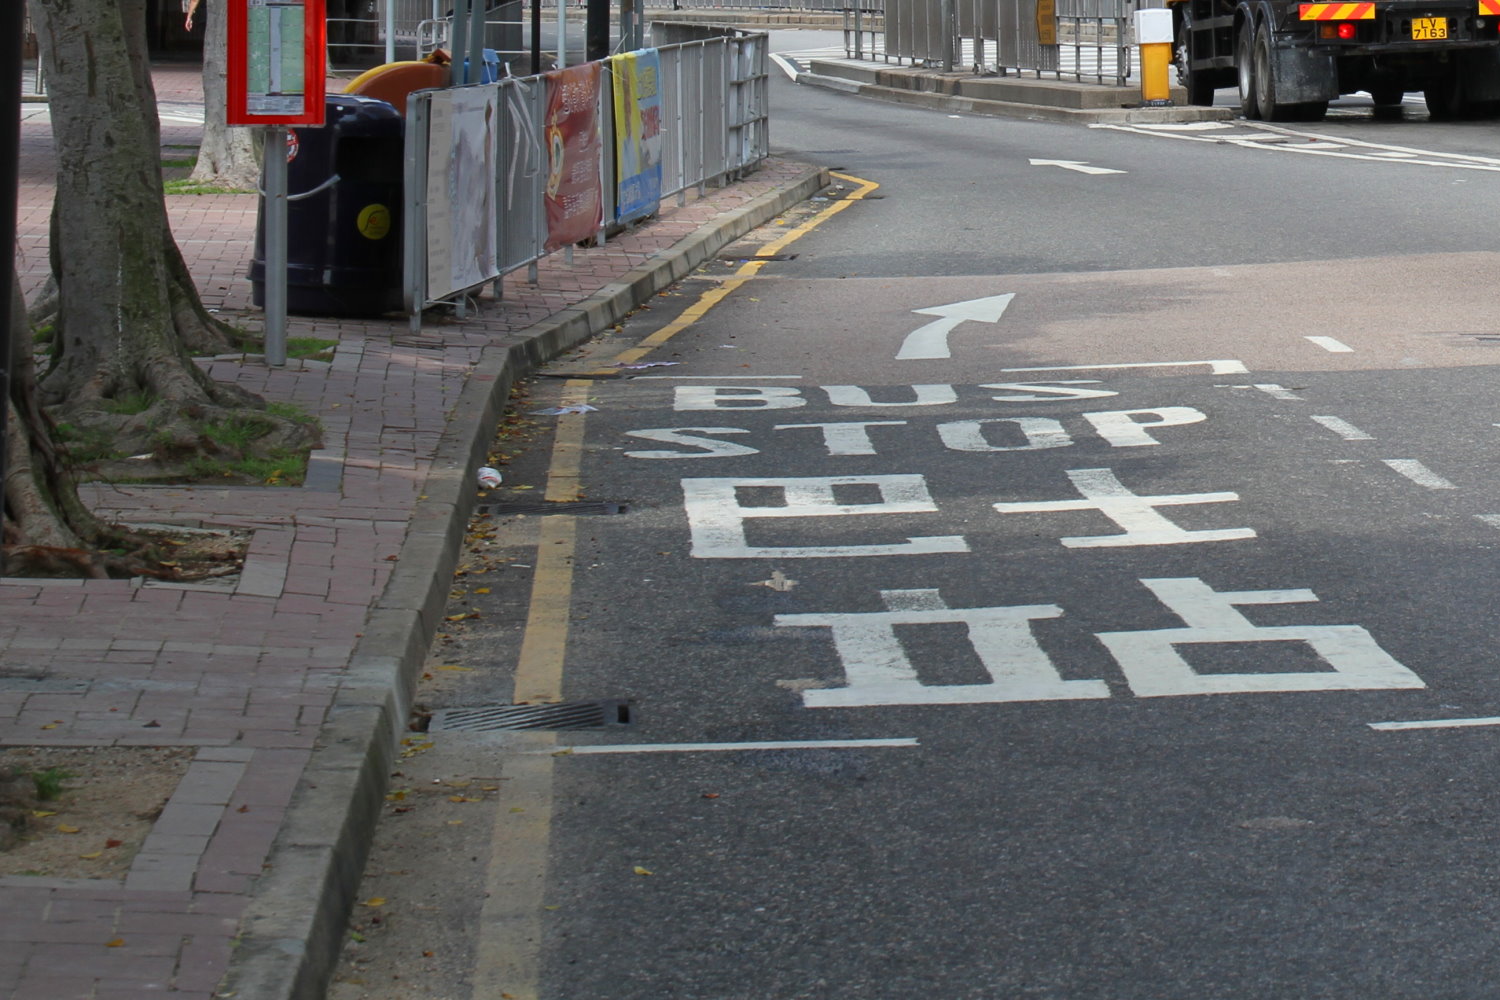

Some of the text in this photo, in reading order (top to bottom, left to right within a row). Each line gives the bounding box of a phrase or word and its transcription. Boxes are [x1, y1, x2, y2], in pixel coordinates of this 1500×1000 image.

[1413, 28, 1446, 39] 7163
[1420, 19, 1437, 29] LV
[673, 379, 1119, 411] BUS
[623, 405, 1207, 459] STOP
[681, 468, 1257, 559] 巴士
